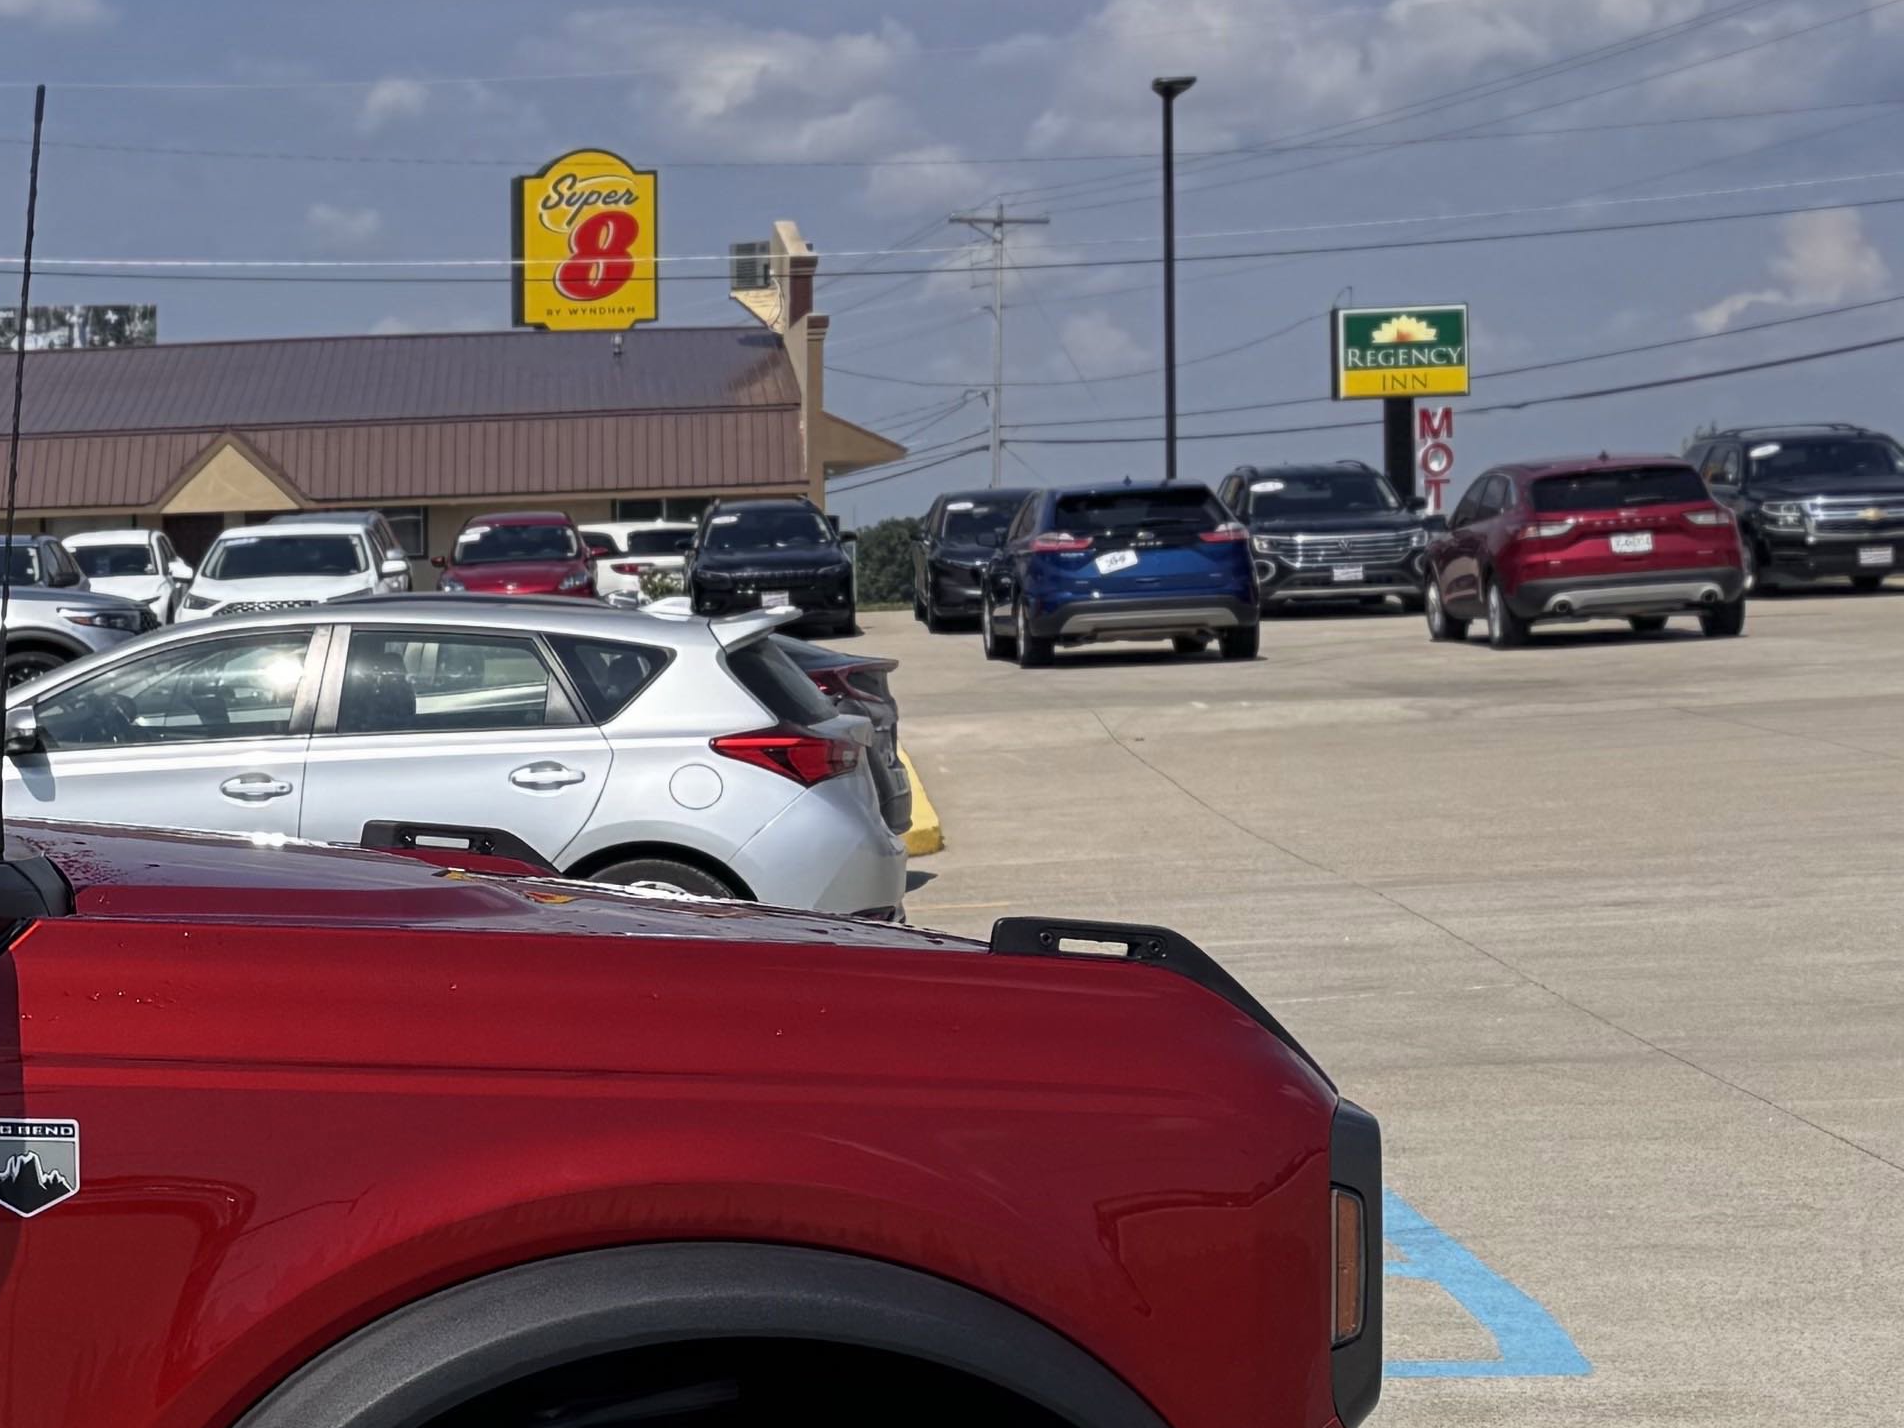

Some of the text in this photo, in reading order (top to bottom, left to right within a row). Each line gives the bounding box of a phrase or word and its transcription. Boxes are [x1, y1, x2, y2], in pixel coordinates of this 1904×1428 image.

[540, 173, 640, 227] Super
[554, 210, 640, 302] 8
[546, 306, 637, 317] BY WYNDHAM
[1346, 346, 1464, 368] REGENCY
[1381, 373, 1429, 392] INN
[18, 1125, 74, 1136] BEND
